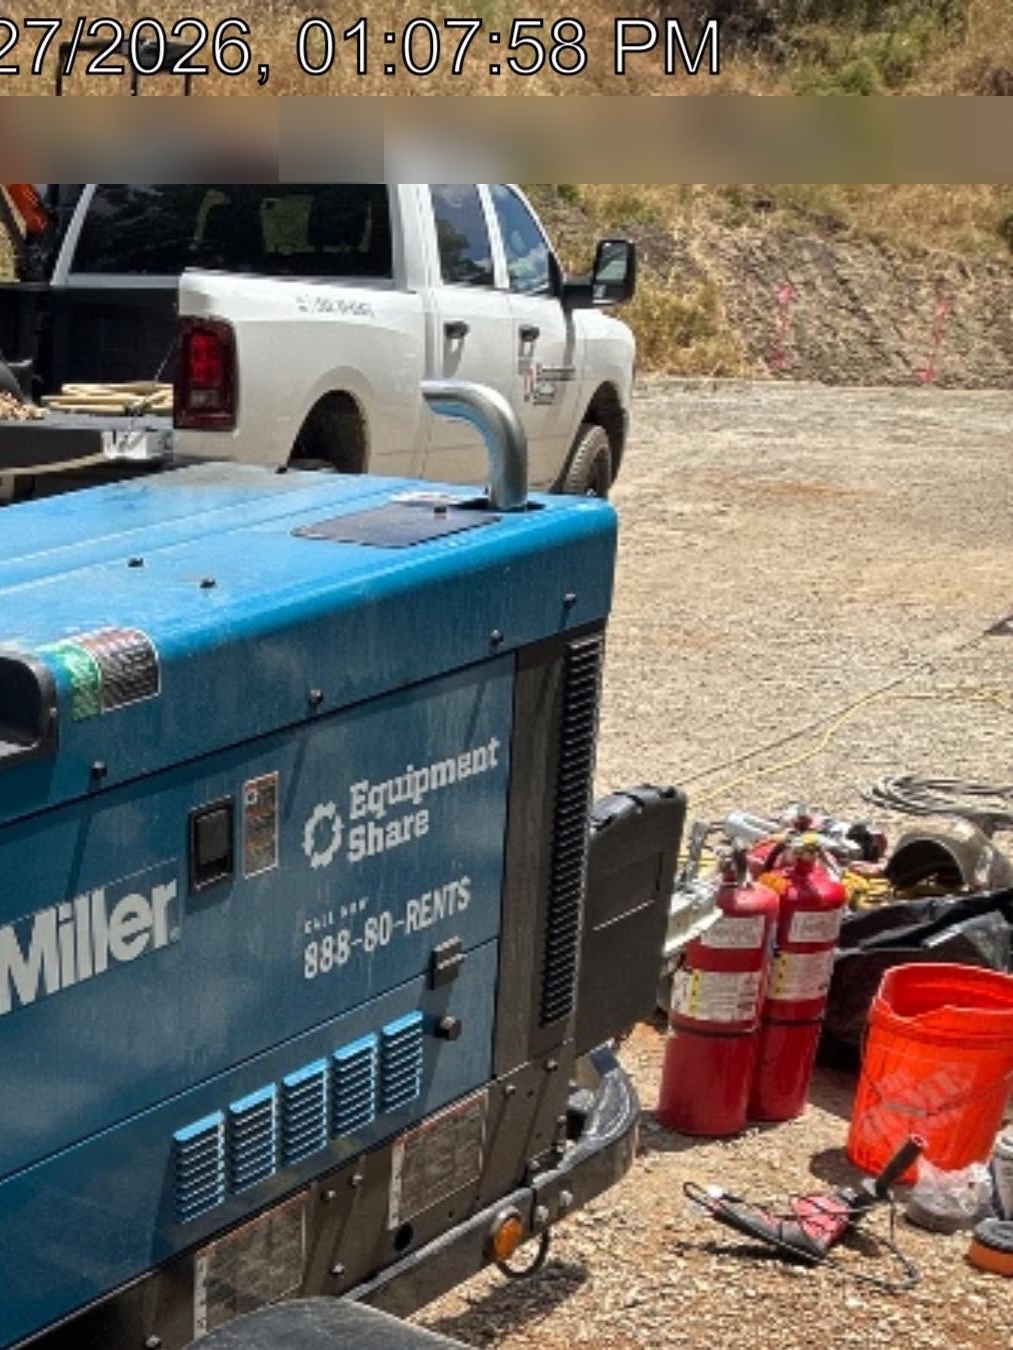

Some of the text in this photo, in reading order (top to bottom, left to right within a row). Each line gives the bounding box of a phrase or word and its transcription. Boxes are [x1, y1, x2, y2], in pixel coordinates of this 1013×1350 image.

[349, 737, 501, 820] Equipment
[347, 808, 430, 864] Share
[303, 875, 472, 980] 888-80-RENTS
